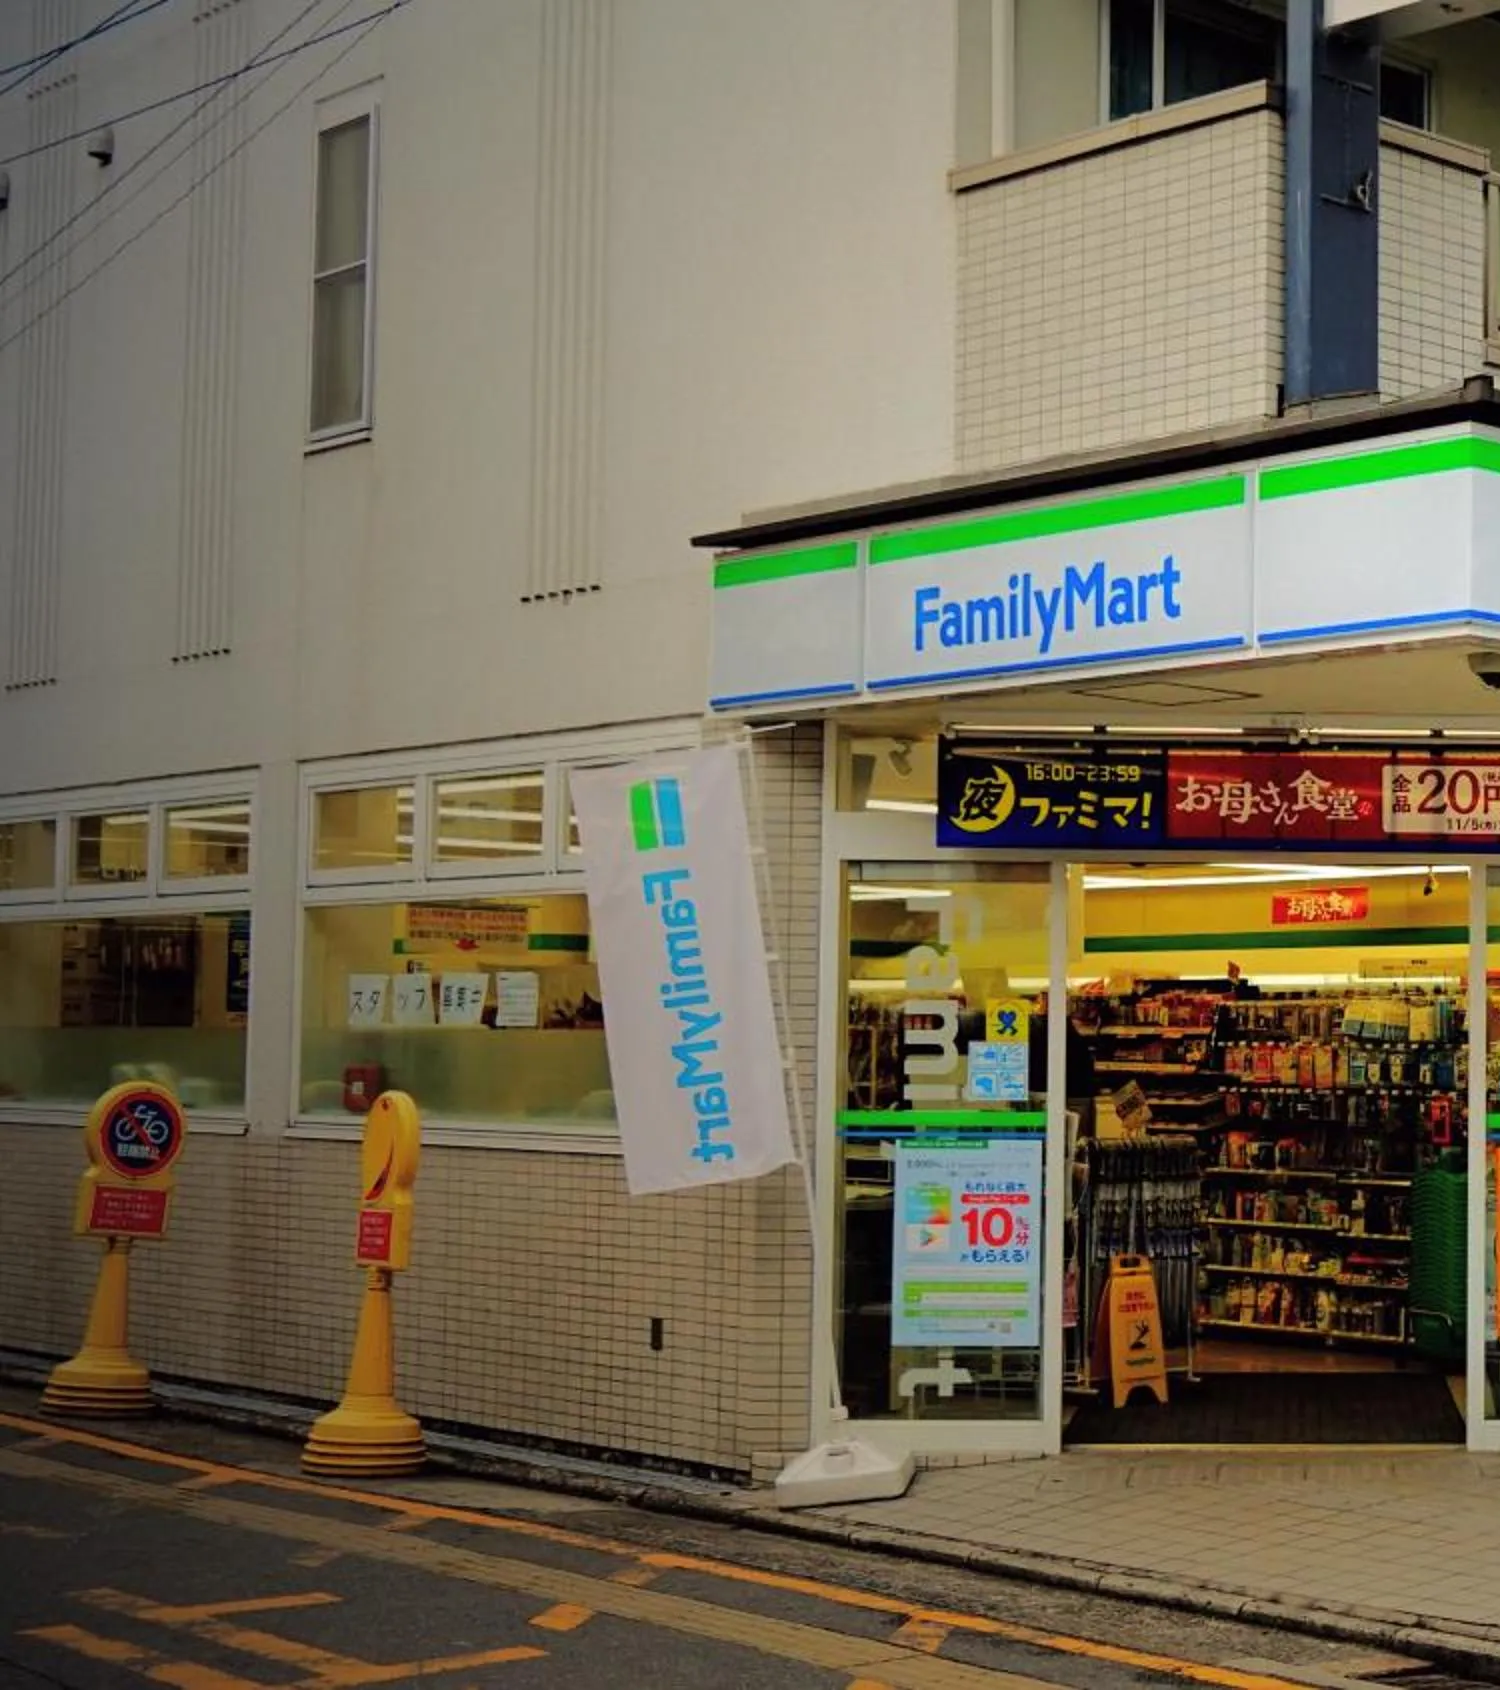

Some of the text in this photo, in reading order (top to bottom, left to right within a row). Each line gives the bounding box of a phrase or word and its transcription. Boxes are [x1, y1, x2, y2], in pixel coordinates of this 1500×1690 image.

[915, 555, 1181, 654] FamilyMart
[1175, 769, 1359, 825] お母さん食堂
[1391, 773, 1412, 814] 全品
